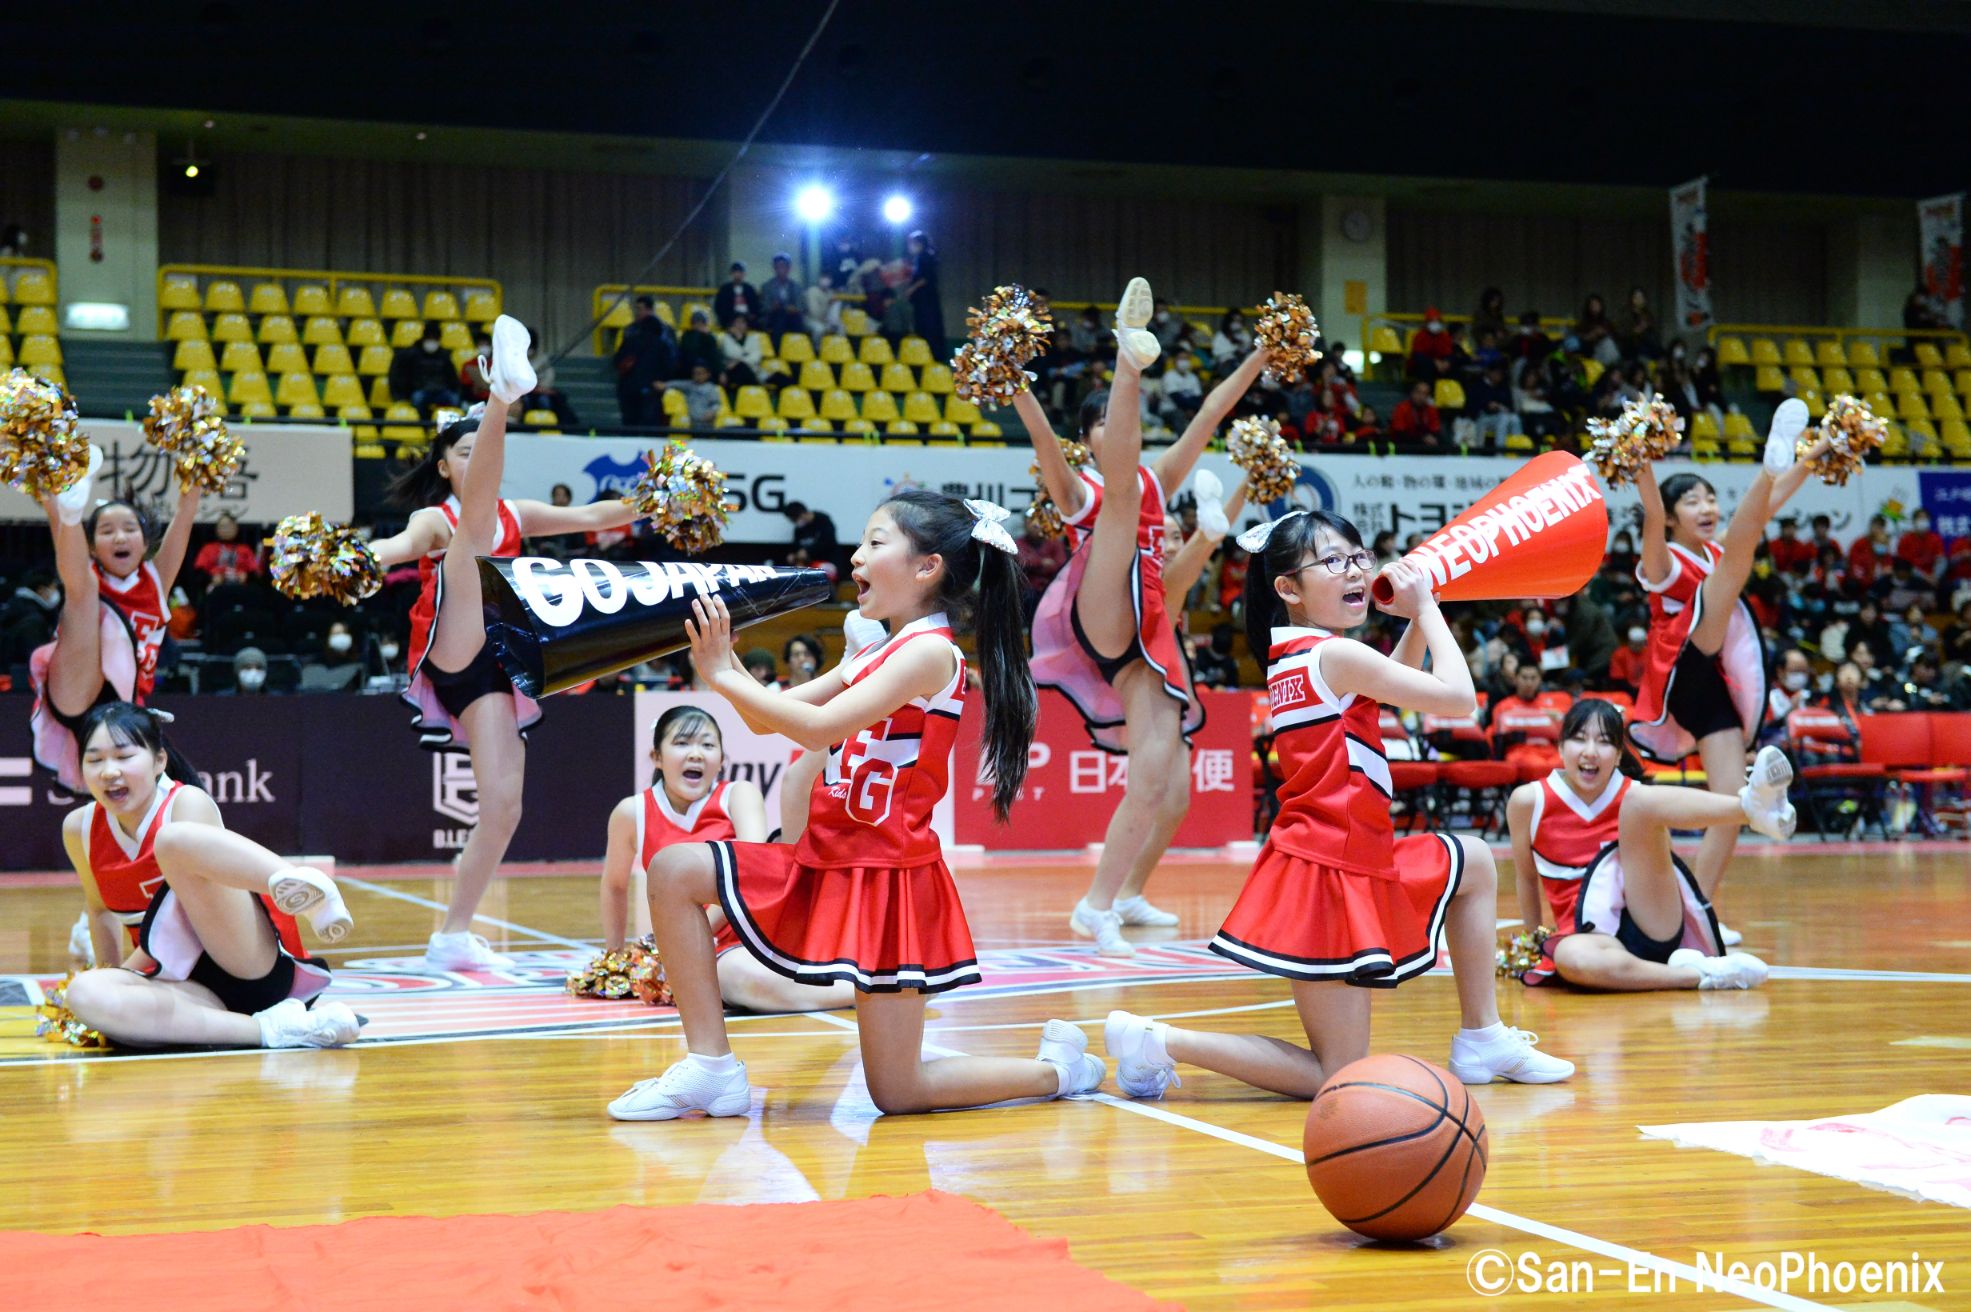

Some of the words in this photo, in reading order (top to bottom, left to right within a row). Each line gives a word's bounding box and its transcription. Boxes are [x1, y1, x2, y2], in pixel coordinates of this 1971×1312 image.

[511, 557, 628, 627] GO
[845, 756, 899, 828] G
[1069, 750, 1235, 793] 日本便
